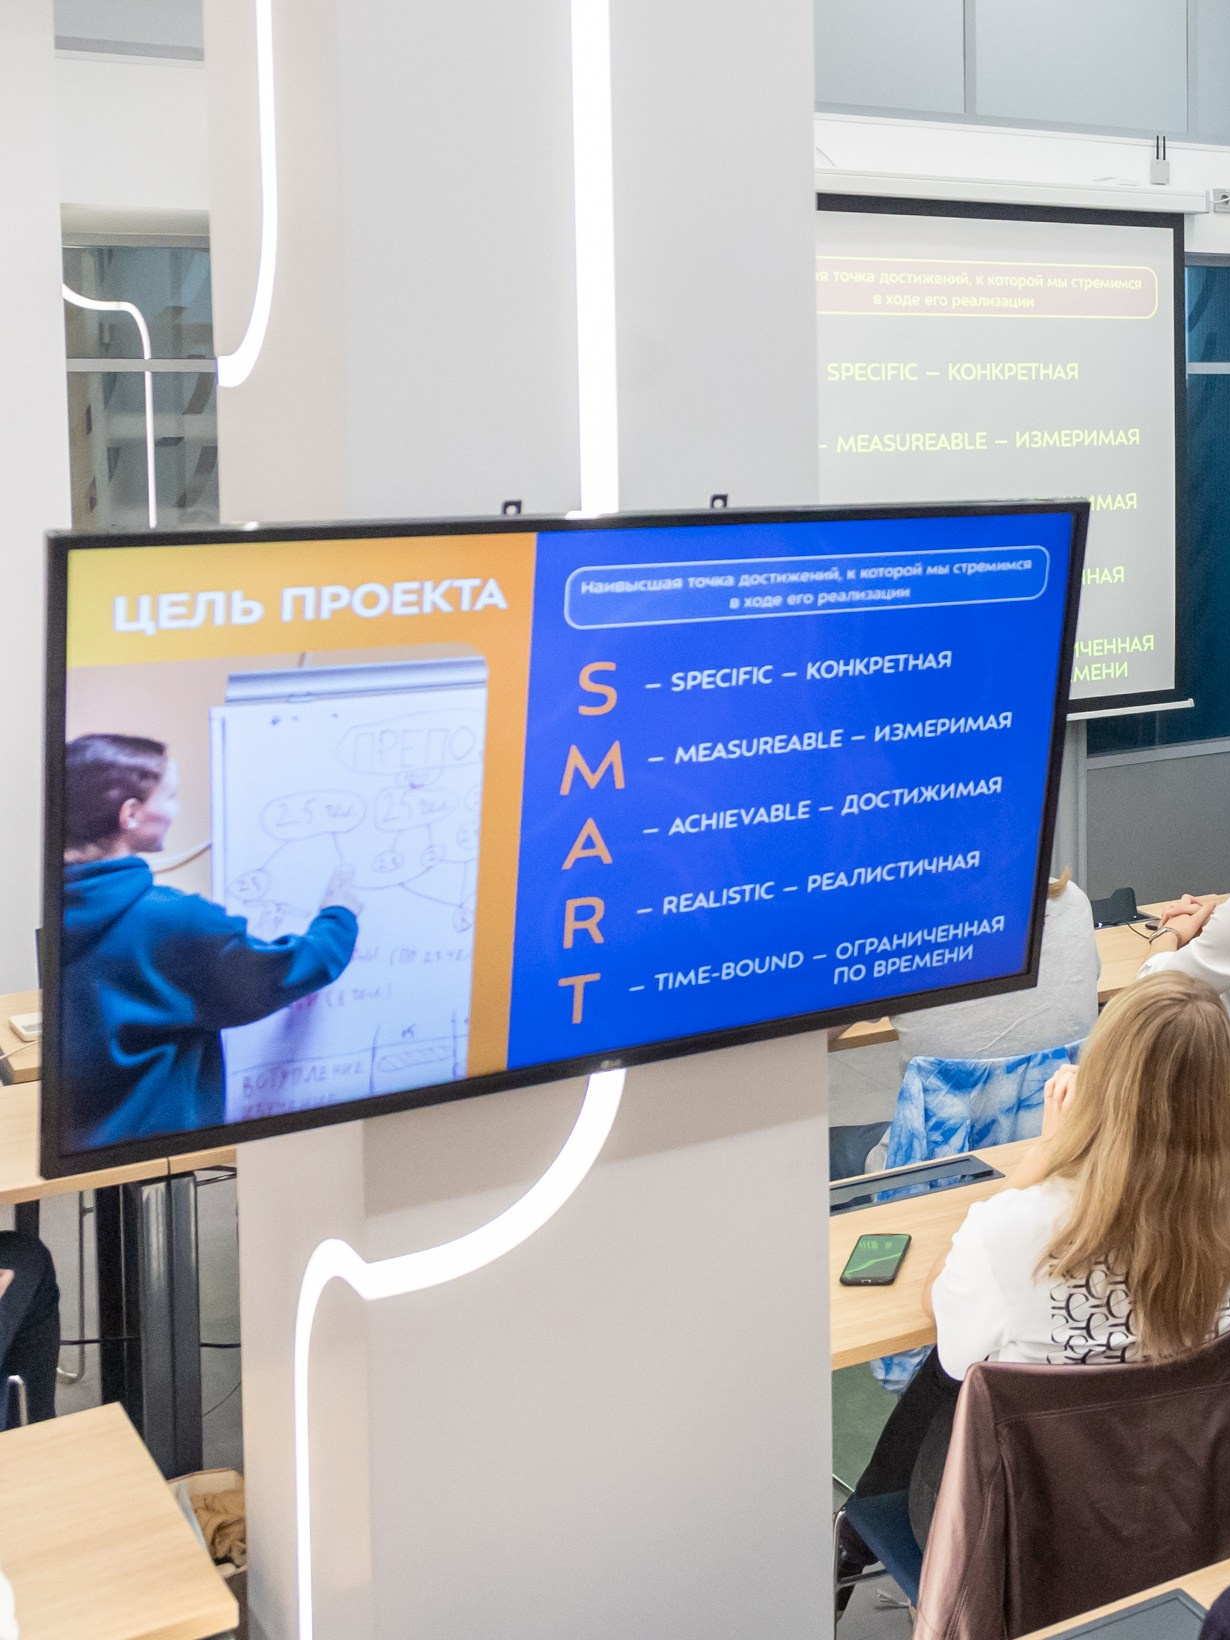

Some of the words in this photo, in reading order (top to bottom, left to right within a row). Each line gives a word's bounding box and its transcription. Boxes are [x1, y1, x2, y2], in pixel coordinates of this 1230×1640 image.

[833, 271, 875, 283] точка
[879, 272, 972, 287] достижений,
[987, 273, 1043, 289] которой
[1047, 278, 1067, 288] мы
[1071, 278, 1142, 291] стремимся
[886, 294, 920, 307] ходе
[924, 296, 948, 306] его
[951, 296, 1035, 309] реализации
[827, 362, 919, 382] SPECIFIC
[948, 362, 1079, 380] КОНКРЕТНАЯ
[837, 432, 986, 453] MEASUREABLE
[1015, 428, 1140, 448] ИЗМЕРИМАЯ
[580, 577, 684, 595] Наивысшая
[687, 575, 735, 589] точка
[737, 566, 843, 588] достижений,
[859, 562, 924, 580] которой
[925, 564, 950, 575] мы
[952, 559, 1033, 576] стремимся
[1082, 565, 1124, 584] НАЯ
[112, 590, 264, 636] ЦЕЛЬ
[280, 578, 508, 622] ПРОЕКТА
[743, 595, 783, 609] ходе
[786, 593, 815, 606] его
[818, 588, 911, 606] реализации
[579, 662, 617, 715] S
[672, 665, 773, 691] SPECIFIC
[806, 651, 952, 680] КОНКРЕТНАЯ
[1070, 660, 1129, 683] МЕНИ
[560, 741, 624, 795] M
[675, 729, 843, 764] MEASUREABLE
[874, 712, 1012, 742] ИЗМЕРИМАЯ
[562, 818, 612, 869] A
[669, 800, 811, 835] ACHIEVABLE
[841, 777, 1002, 816] ДОСТИЖИМАЯ
[563, 897, 604, 948] R
[663, 882, 774, 914] REALISTIC
[808, 851, 980, 892] РЕАЛИСТИЧНАЯ
[559, 973, 600, 1024] T
[655, 951, 804, 991] TIME-BOUND
[836, 915, 1005, 961] ОГРАНИЧЕННАЯ
[834, 964, 866, 984] ПО
[874, 944, 974, 979] ВРЕМЕНИ
